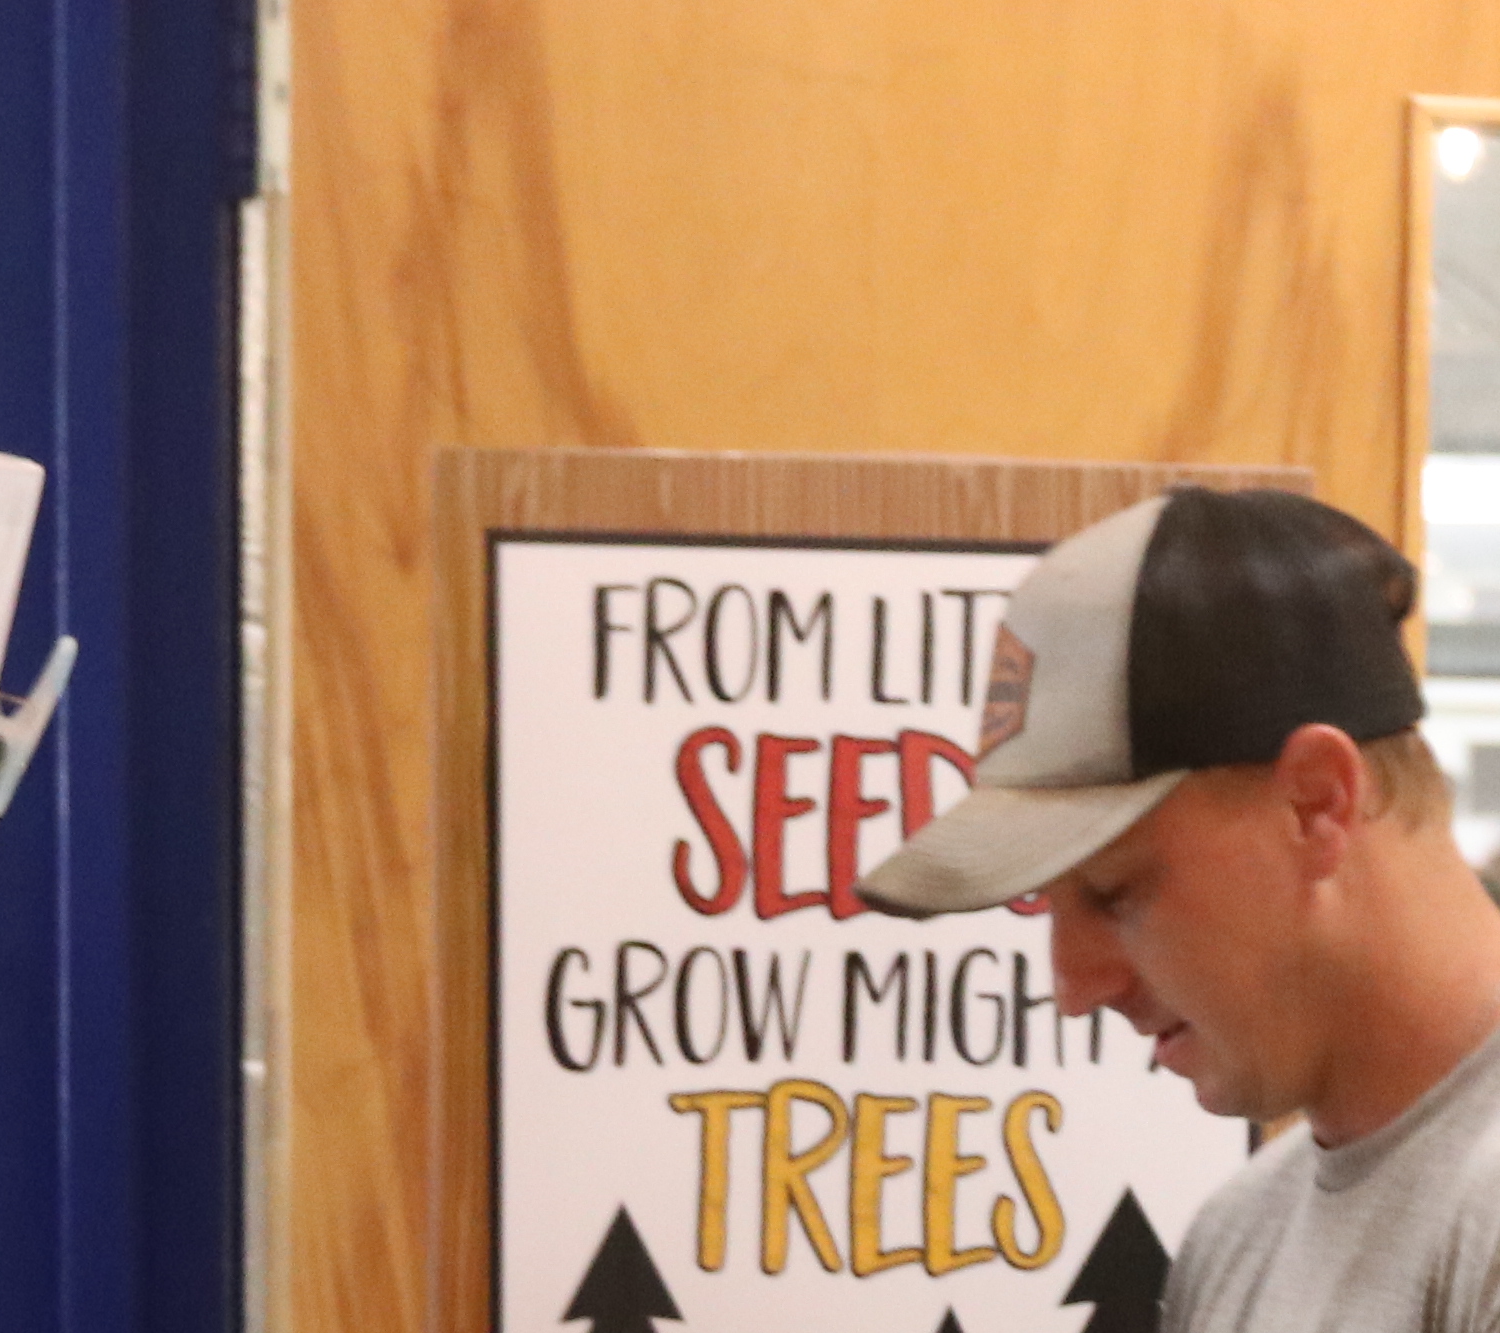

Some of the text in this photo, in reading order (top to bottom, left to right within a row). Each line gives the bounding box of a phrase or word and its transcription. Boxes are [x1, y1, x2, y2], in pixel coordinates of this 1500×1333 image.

[592, 575, 833, 705] FROM
[672, 725, 1052, 921] SEED
[544, 941, 1160, 1073] GROW MIGH
[668, 1077, 1067, 1278] TREES
